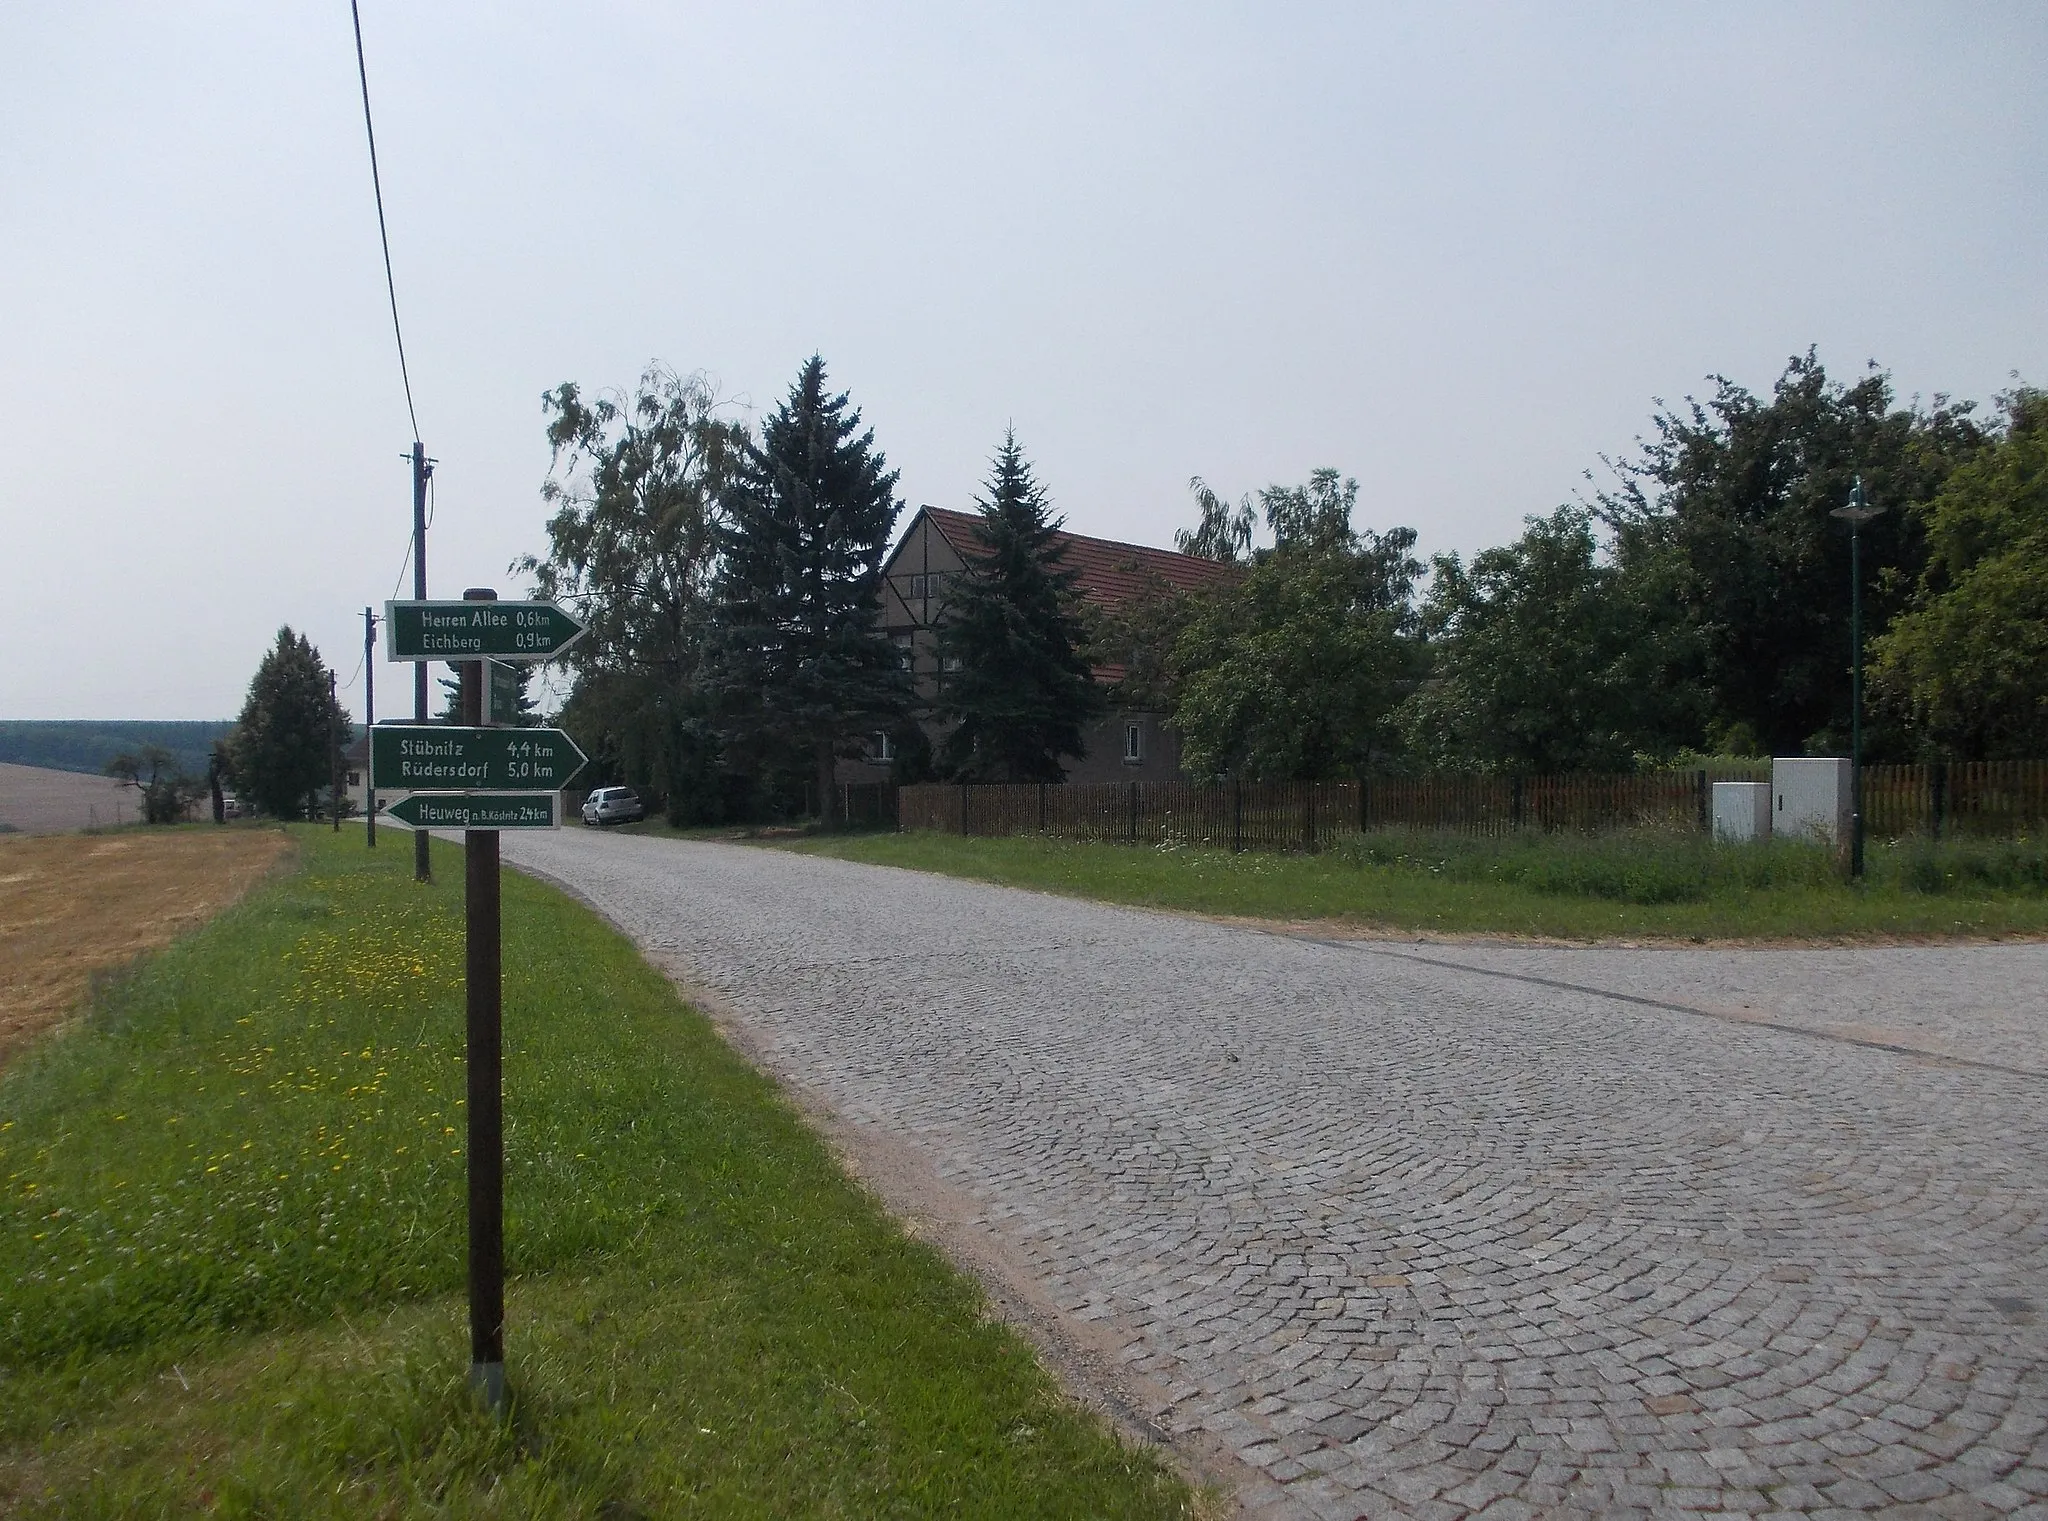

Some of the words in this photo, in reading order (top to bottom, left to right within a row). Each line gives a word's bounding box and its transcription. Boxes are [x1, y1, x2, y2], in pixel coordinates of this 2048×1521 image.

[422, 610, 467, 627] Herren
[471, 610, 508, 627] Allee
[423, 633, 481, 651] Eichberg
[400, 739, 464, 756] Stübnitz
[506, 741, 531, 759] 4,4
[534, 742, 553, 757] km
[402, 761, 489, 778] Rüdersdorf
[508, 761, 529, 778] 5,0
[533, 761, 553, 777] km
[420, 803, 470, 823] Heuweg
